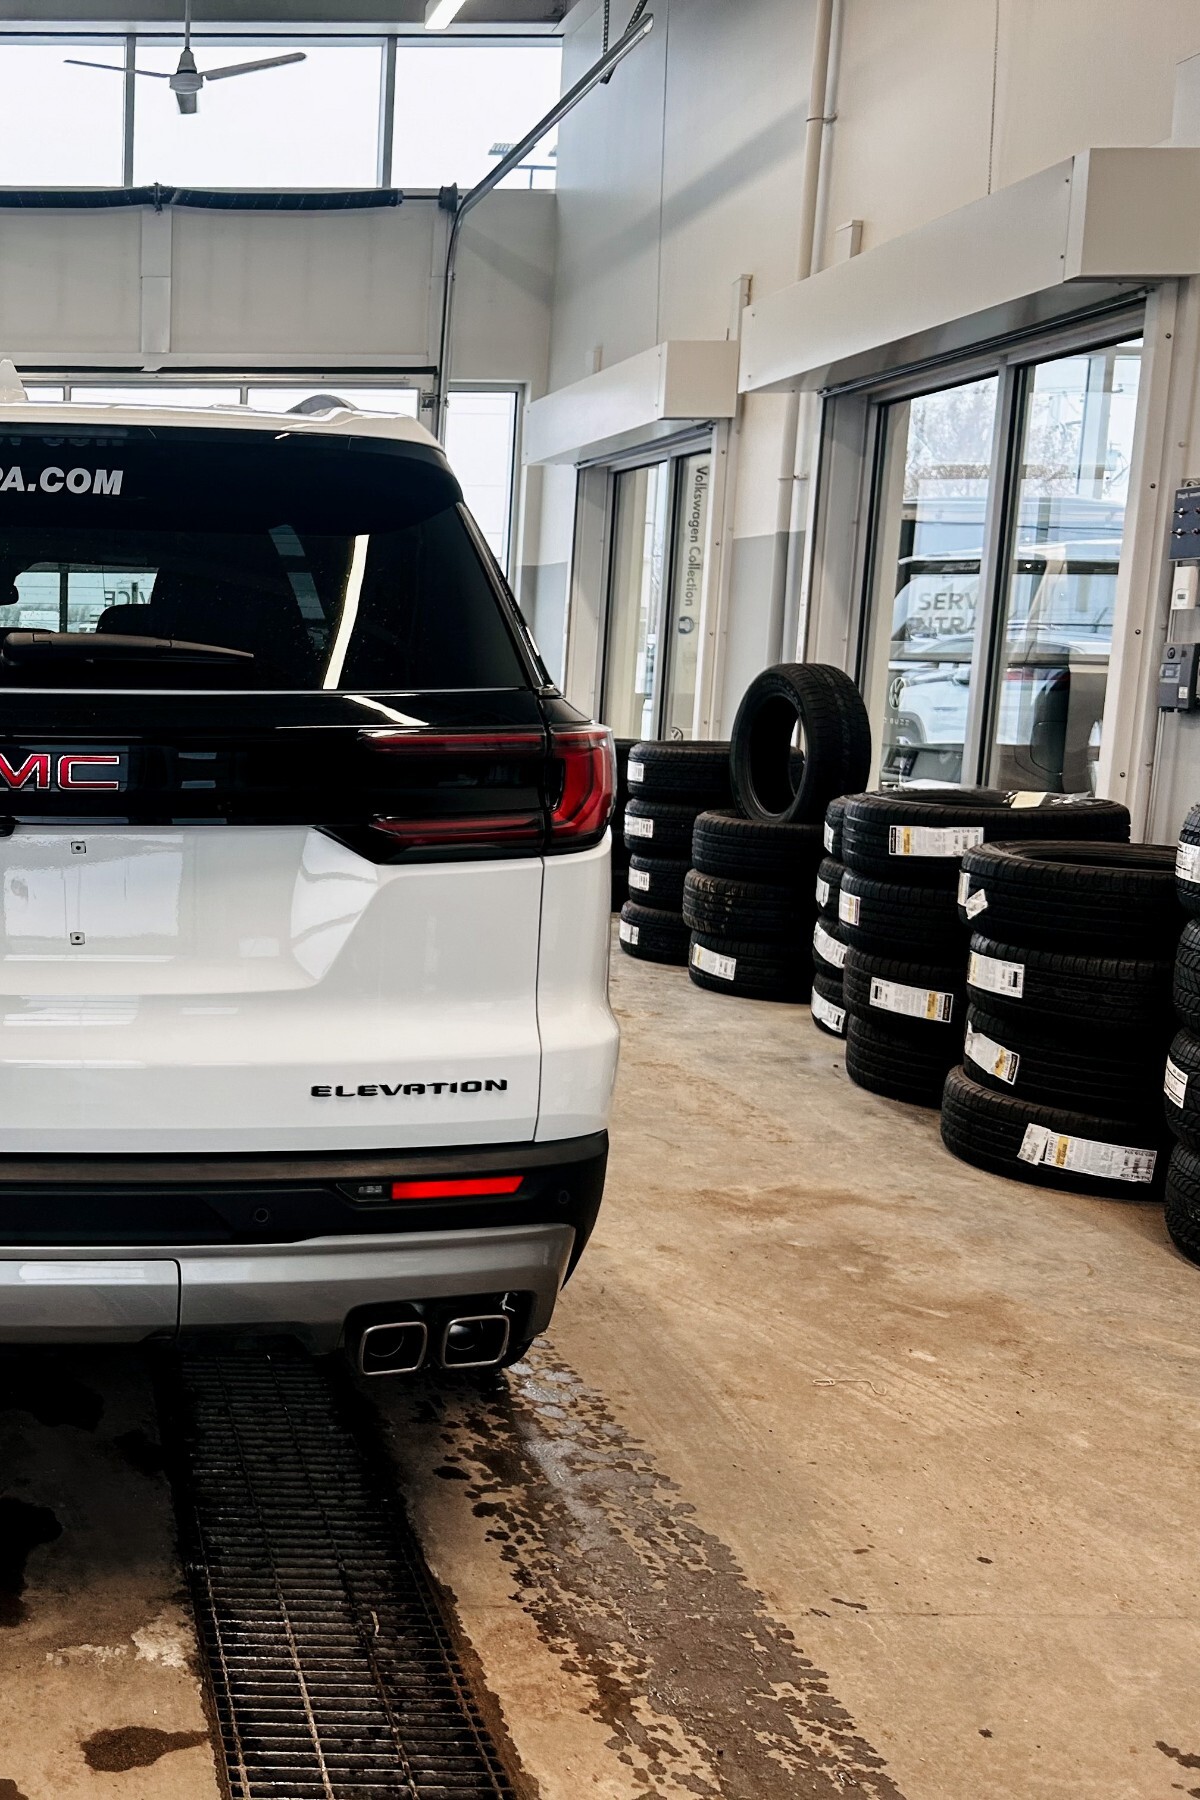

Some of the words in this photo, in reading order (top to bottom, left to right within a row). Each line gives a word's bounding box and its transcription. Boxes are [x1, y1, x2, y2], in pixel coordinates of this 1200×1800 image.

[688, 465, 709, 542] Volkswagen
[684, 546, 701, 607] Collection
[310, 1079, 508, 1097] ELEVATION
